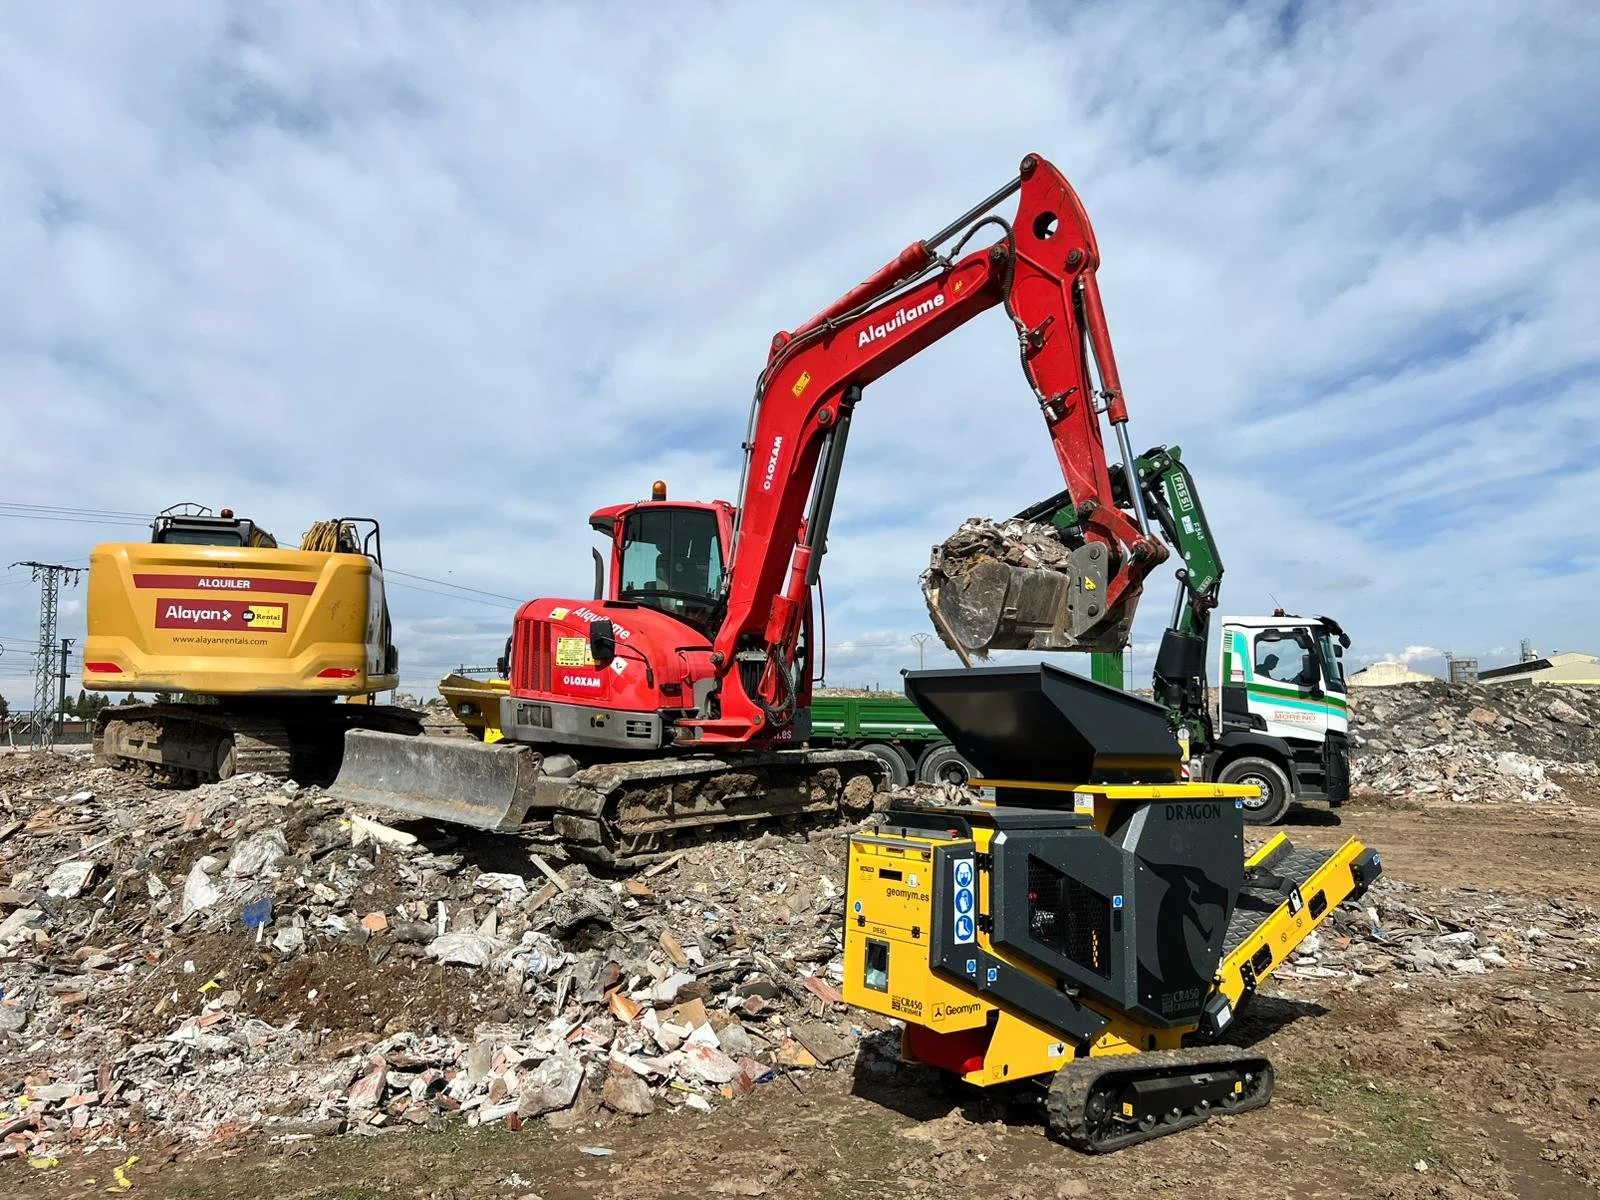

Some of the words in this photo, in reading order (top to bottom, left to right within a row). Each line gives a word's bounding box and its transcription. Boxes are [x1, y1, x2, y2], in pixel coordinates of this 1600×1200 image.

[857, 293, 945, 348] Alquílame
[1173, 474, 1192, 510] FASSI
[198, 578, 251, 589] ALQUILER
[165, 605, 221, 622] Alayan
[256, 613, 281, 621] Rental
[572, 607, 631, 640] Alqume
[172, 635, 268, 646] www.alayanrentals.com
[1274, 713, 1316, 721] MORENO
[1165, 803, 1221, 821] DRAGON
[886, 887, 930, 902] geomym.es
[872, 926, 887, 936] DIESEL
[1173, 988, 1200, 1003] CR450
[900, 997, 923, 1010] CR450
[945, 1003, 981, 1016] Geomym
